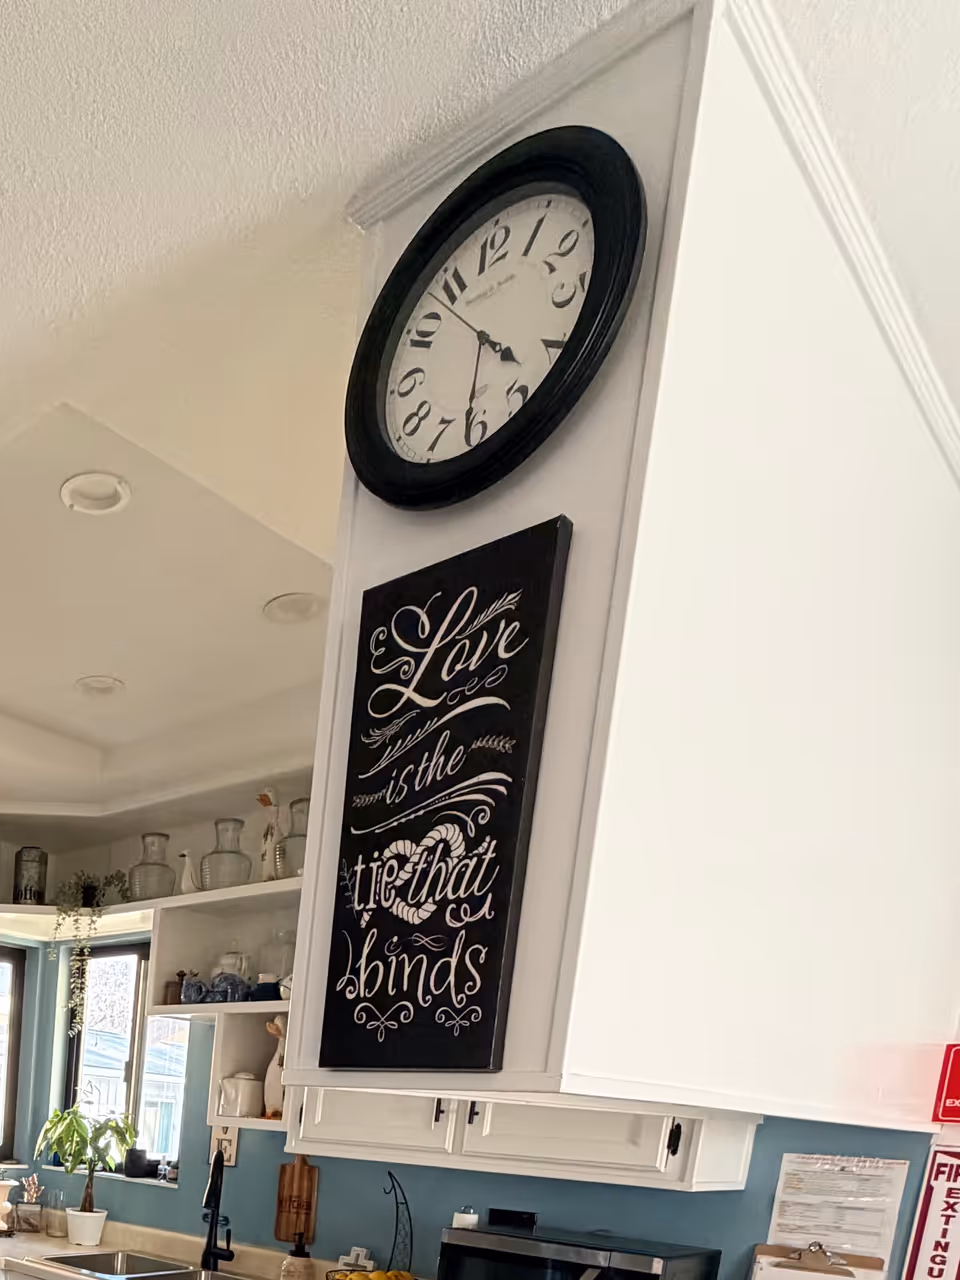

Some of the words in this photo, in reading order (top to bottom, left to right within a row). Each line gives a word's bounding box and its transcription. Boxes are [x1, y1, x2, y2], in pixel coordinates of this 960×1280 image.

[477, 225, 511, 276] 12
[521, 212, 549, 257] 1
[543, 229, 580, 274] 2
[442, 267, 468, 305] 11
[552, 270, 587, 309] 3
[410, 312, 442, 349] 10
[397, 367, 425, 399] 9
[402, 400, 431, 437] 8
[427, 417, 456, 453] 7
[464, 407, 488, 448] 6
[368, 586, 529, 718] Love
[386, 764, 415, 805] is
[415, 730, 467, 792] the
[353, 851, 399, 911] tie
[407, 840, 500, 904] that
[356, 928, 488, 1008] binds
